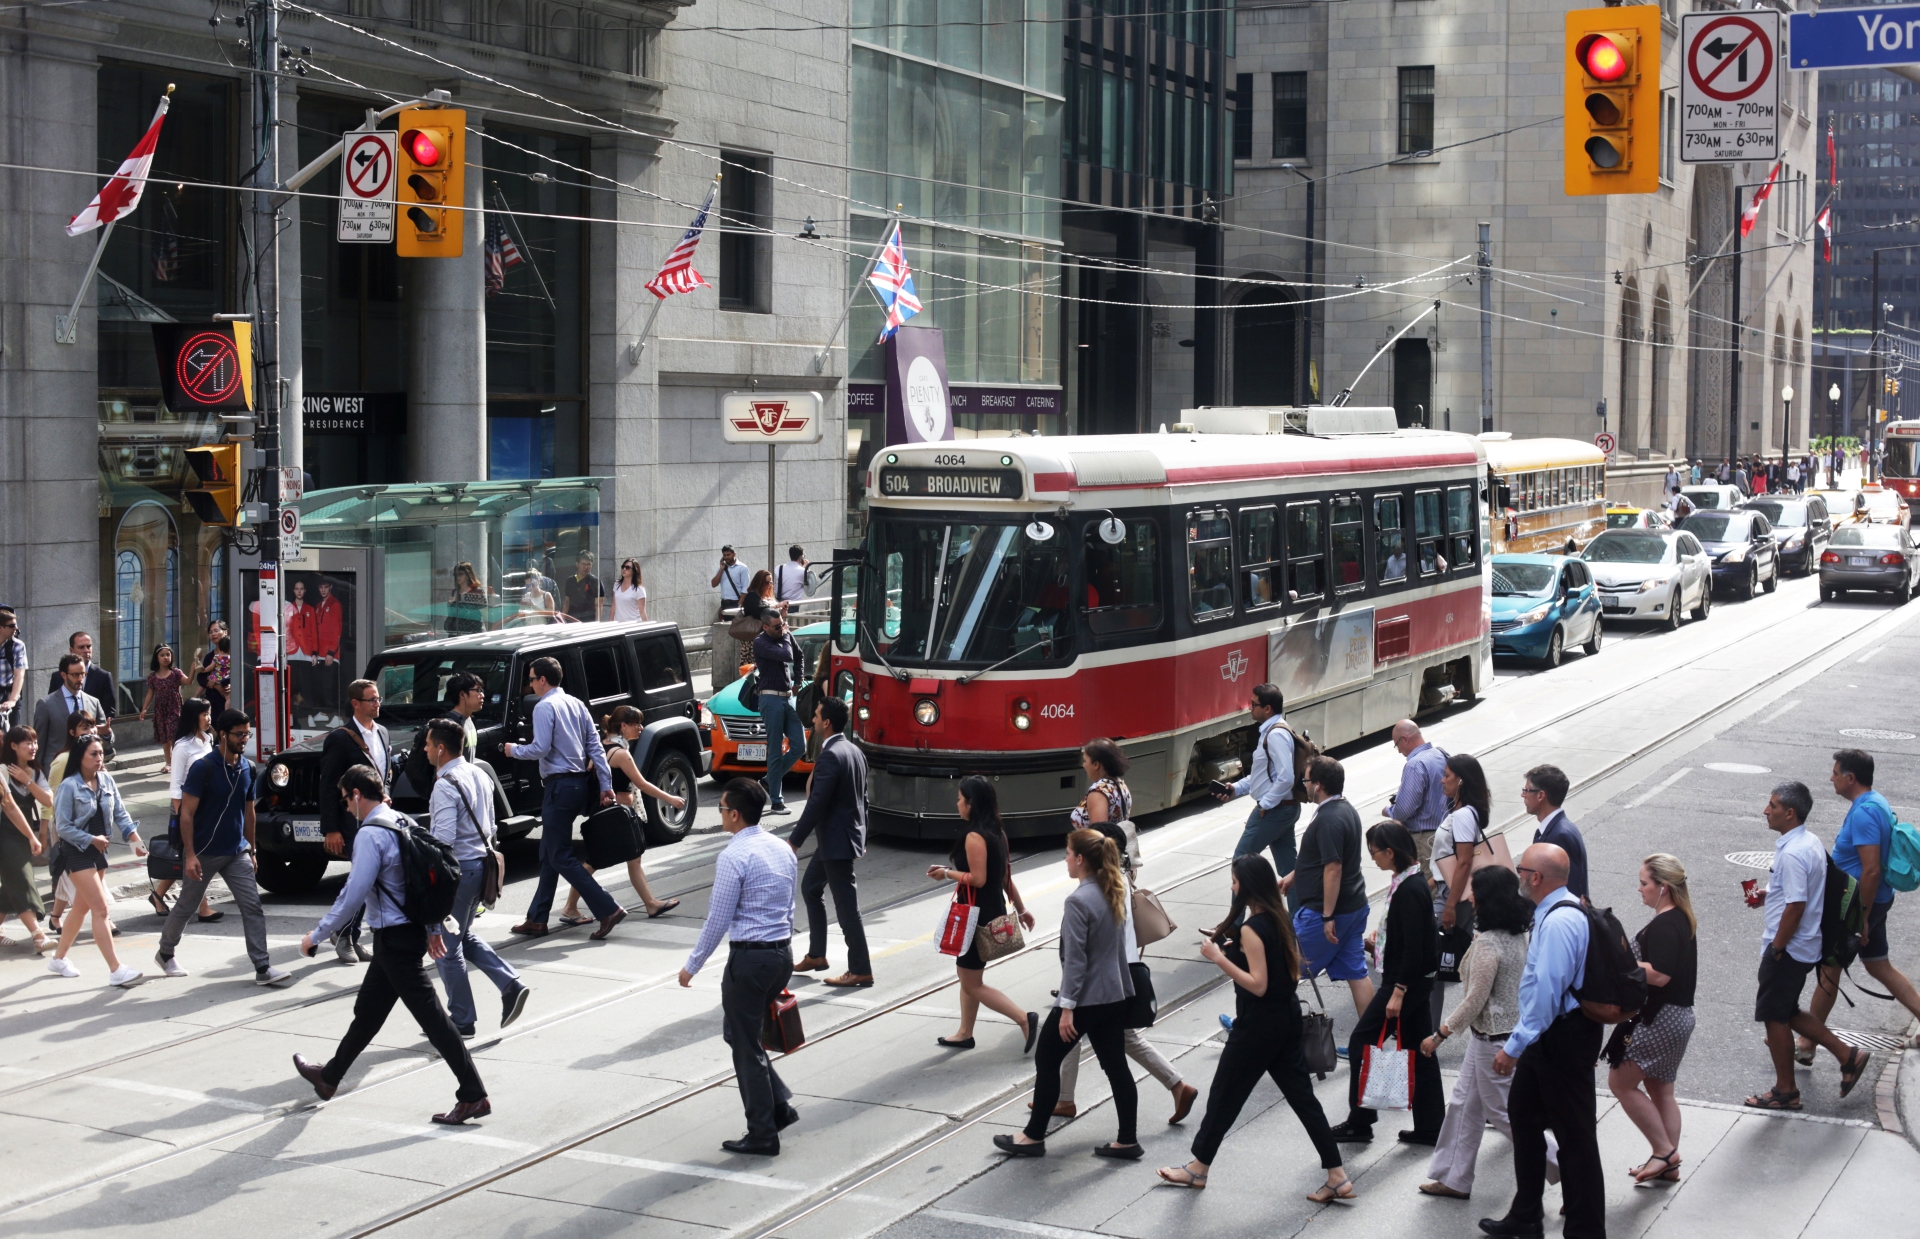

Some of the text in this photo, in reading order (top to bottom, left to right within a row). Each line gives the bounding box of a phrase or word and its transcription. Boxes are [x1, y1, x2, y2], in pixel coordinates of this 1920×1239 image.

[1735, 120, 1746, 128] FRI
[1685, 133, 1721, 148] 730AM
[1736, 132, 1774, 147] 630PM
[1714, 150, 1744, 158] SATURDAY
[909, 386, 940, 403] PLENTY
[333, 397, 364, 414] WEST
[981, 395, 1016, 407] BREAKFAST
[1026, 396, 1055, 408] CATERING
[309, 419, 364, 429] RESIDENCE
[934, 454, 966, 466] 4064
[284, 469, 294, 479] NO
[886, 475, 1001, 494] 504 BROADVIEW
[259, 562, 275, 570] 24hr
[1040, 703, 1075, 719] 4064
